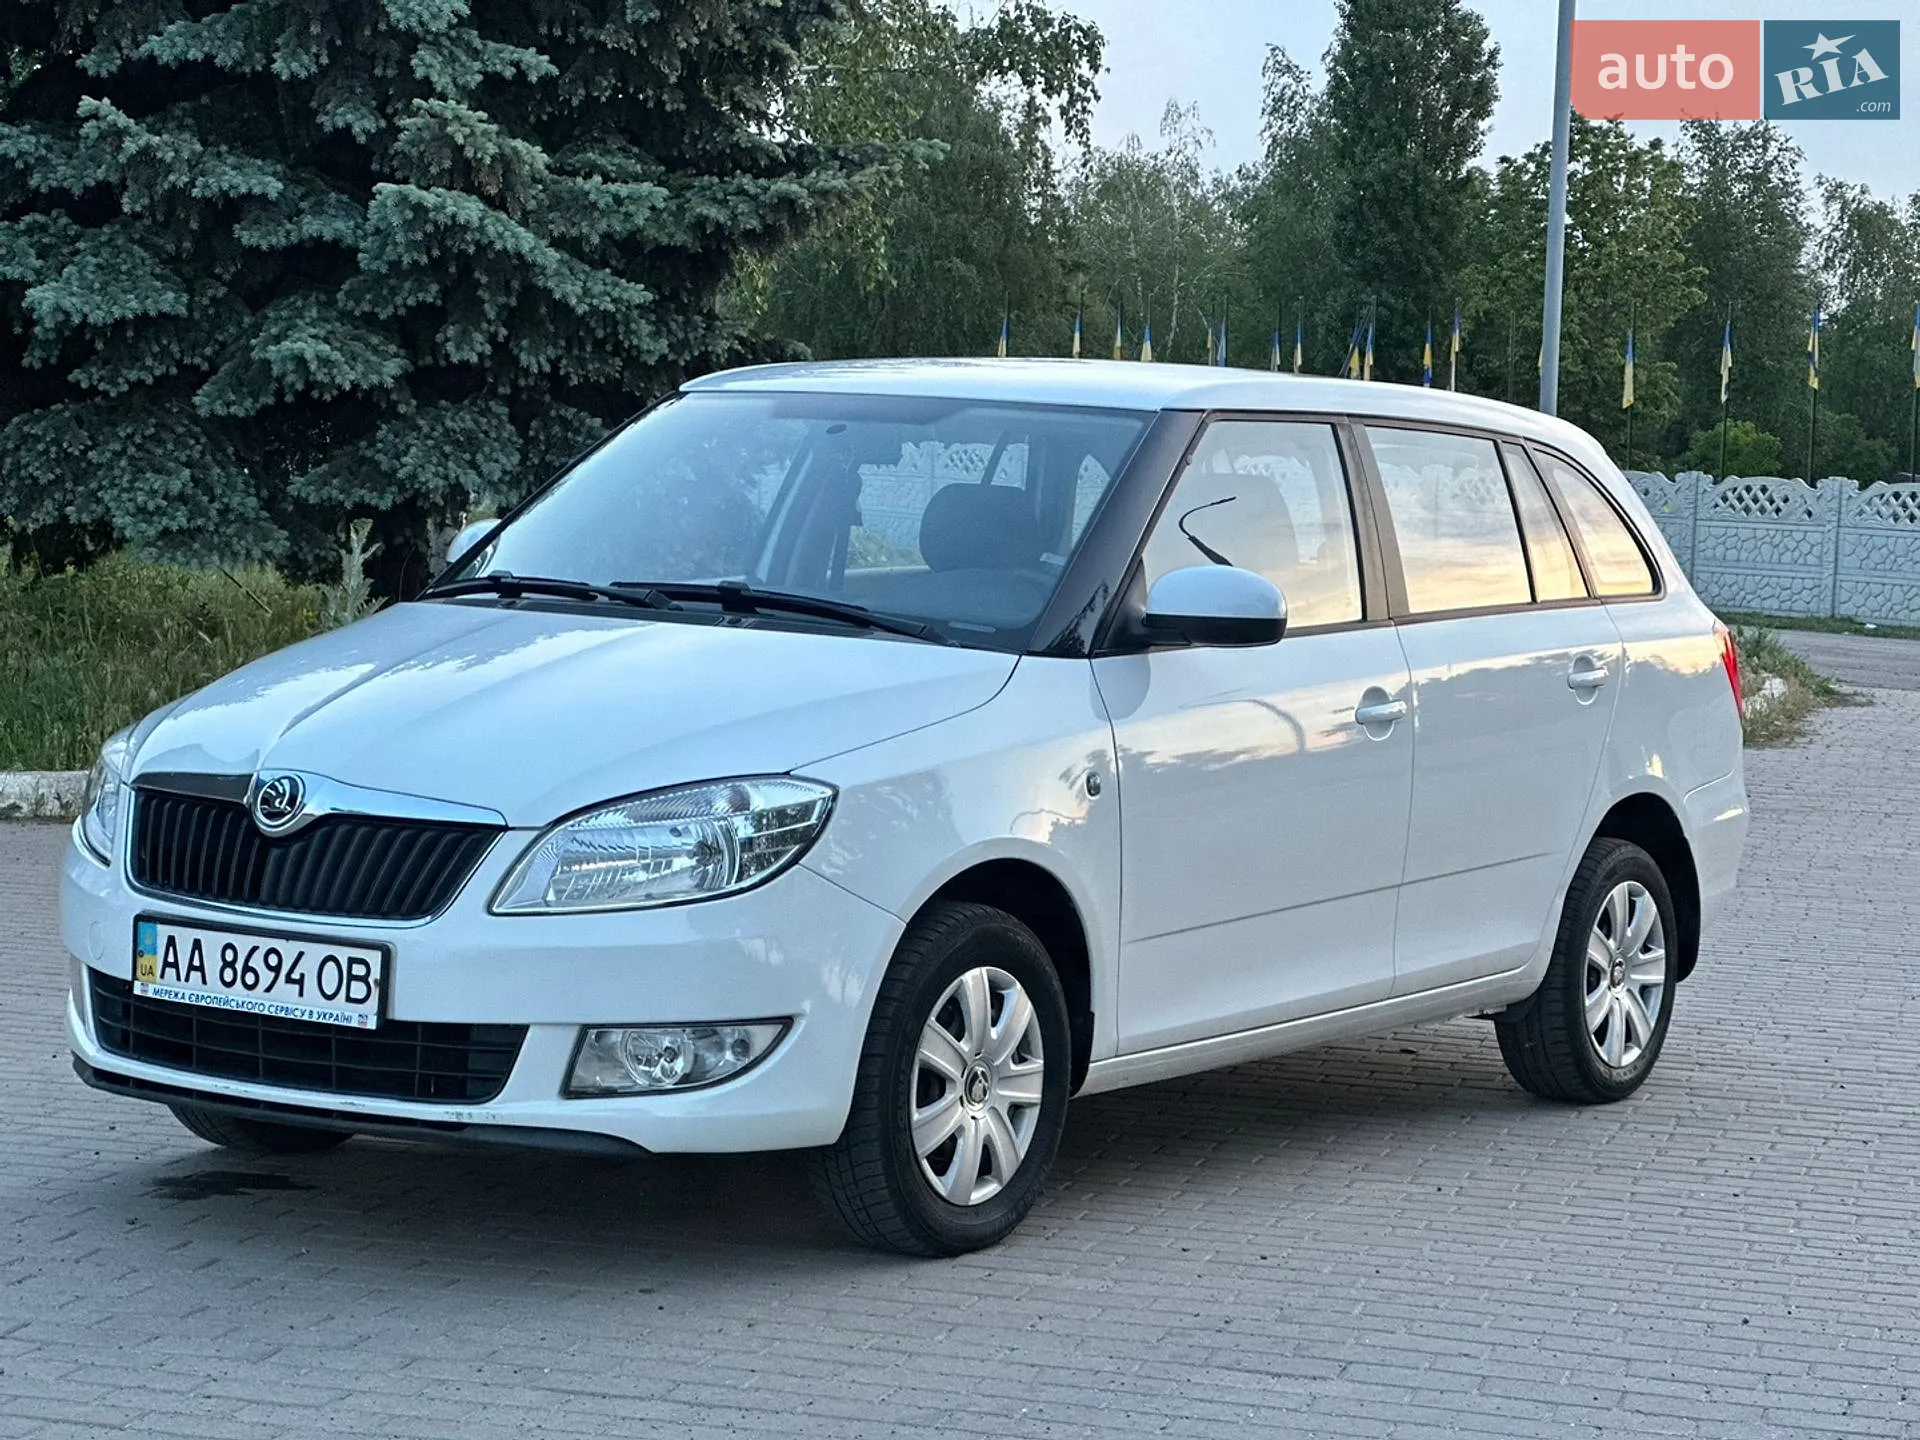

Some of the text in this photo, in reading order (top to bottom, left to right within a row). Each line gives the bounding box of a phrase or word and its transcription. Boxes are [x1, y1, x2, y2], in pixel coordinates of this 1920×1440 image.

[140, 964, 155, 977] UA
[159, 934, 372, 1004] AA 8694 OB
[152, 987, 186, 1001] МЕРЕЖА
[188, 993, 266, 1013] ЄВРОПЕЙСЬКОГО
[267, 1004, 307, 1019] СЕРВІСУ
[315, 1010, 352, 1024] УКРАЇНІ
